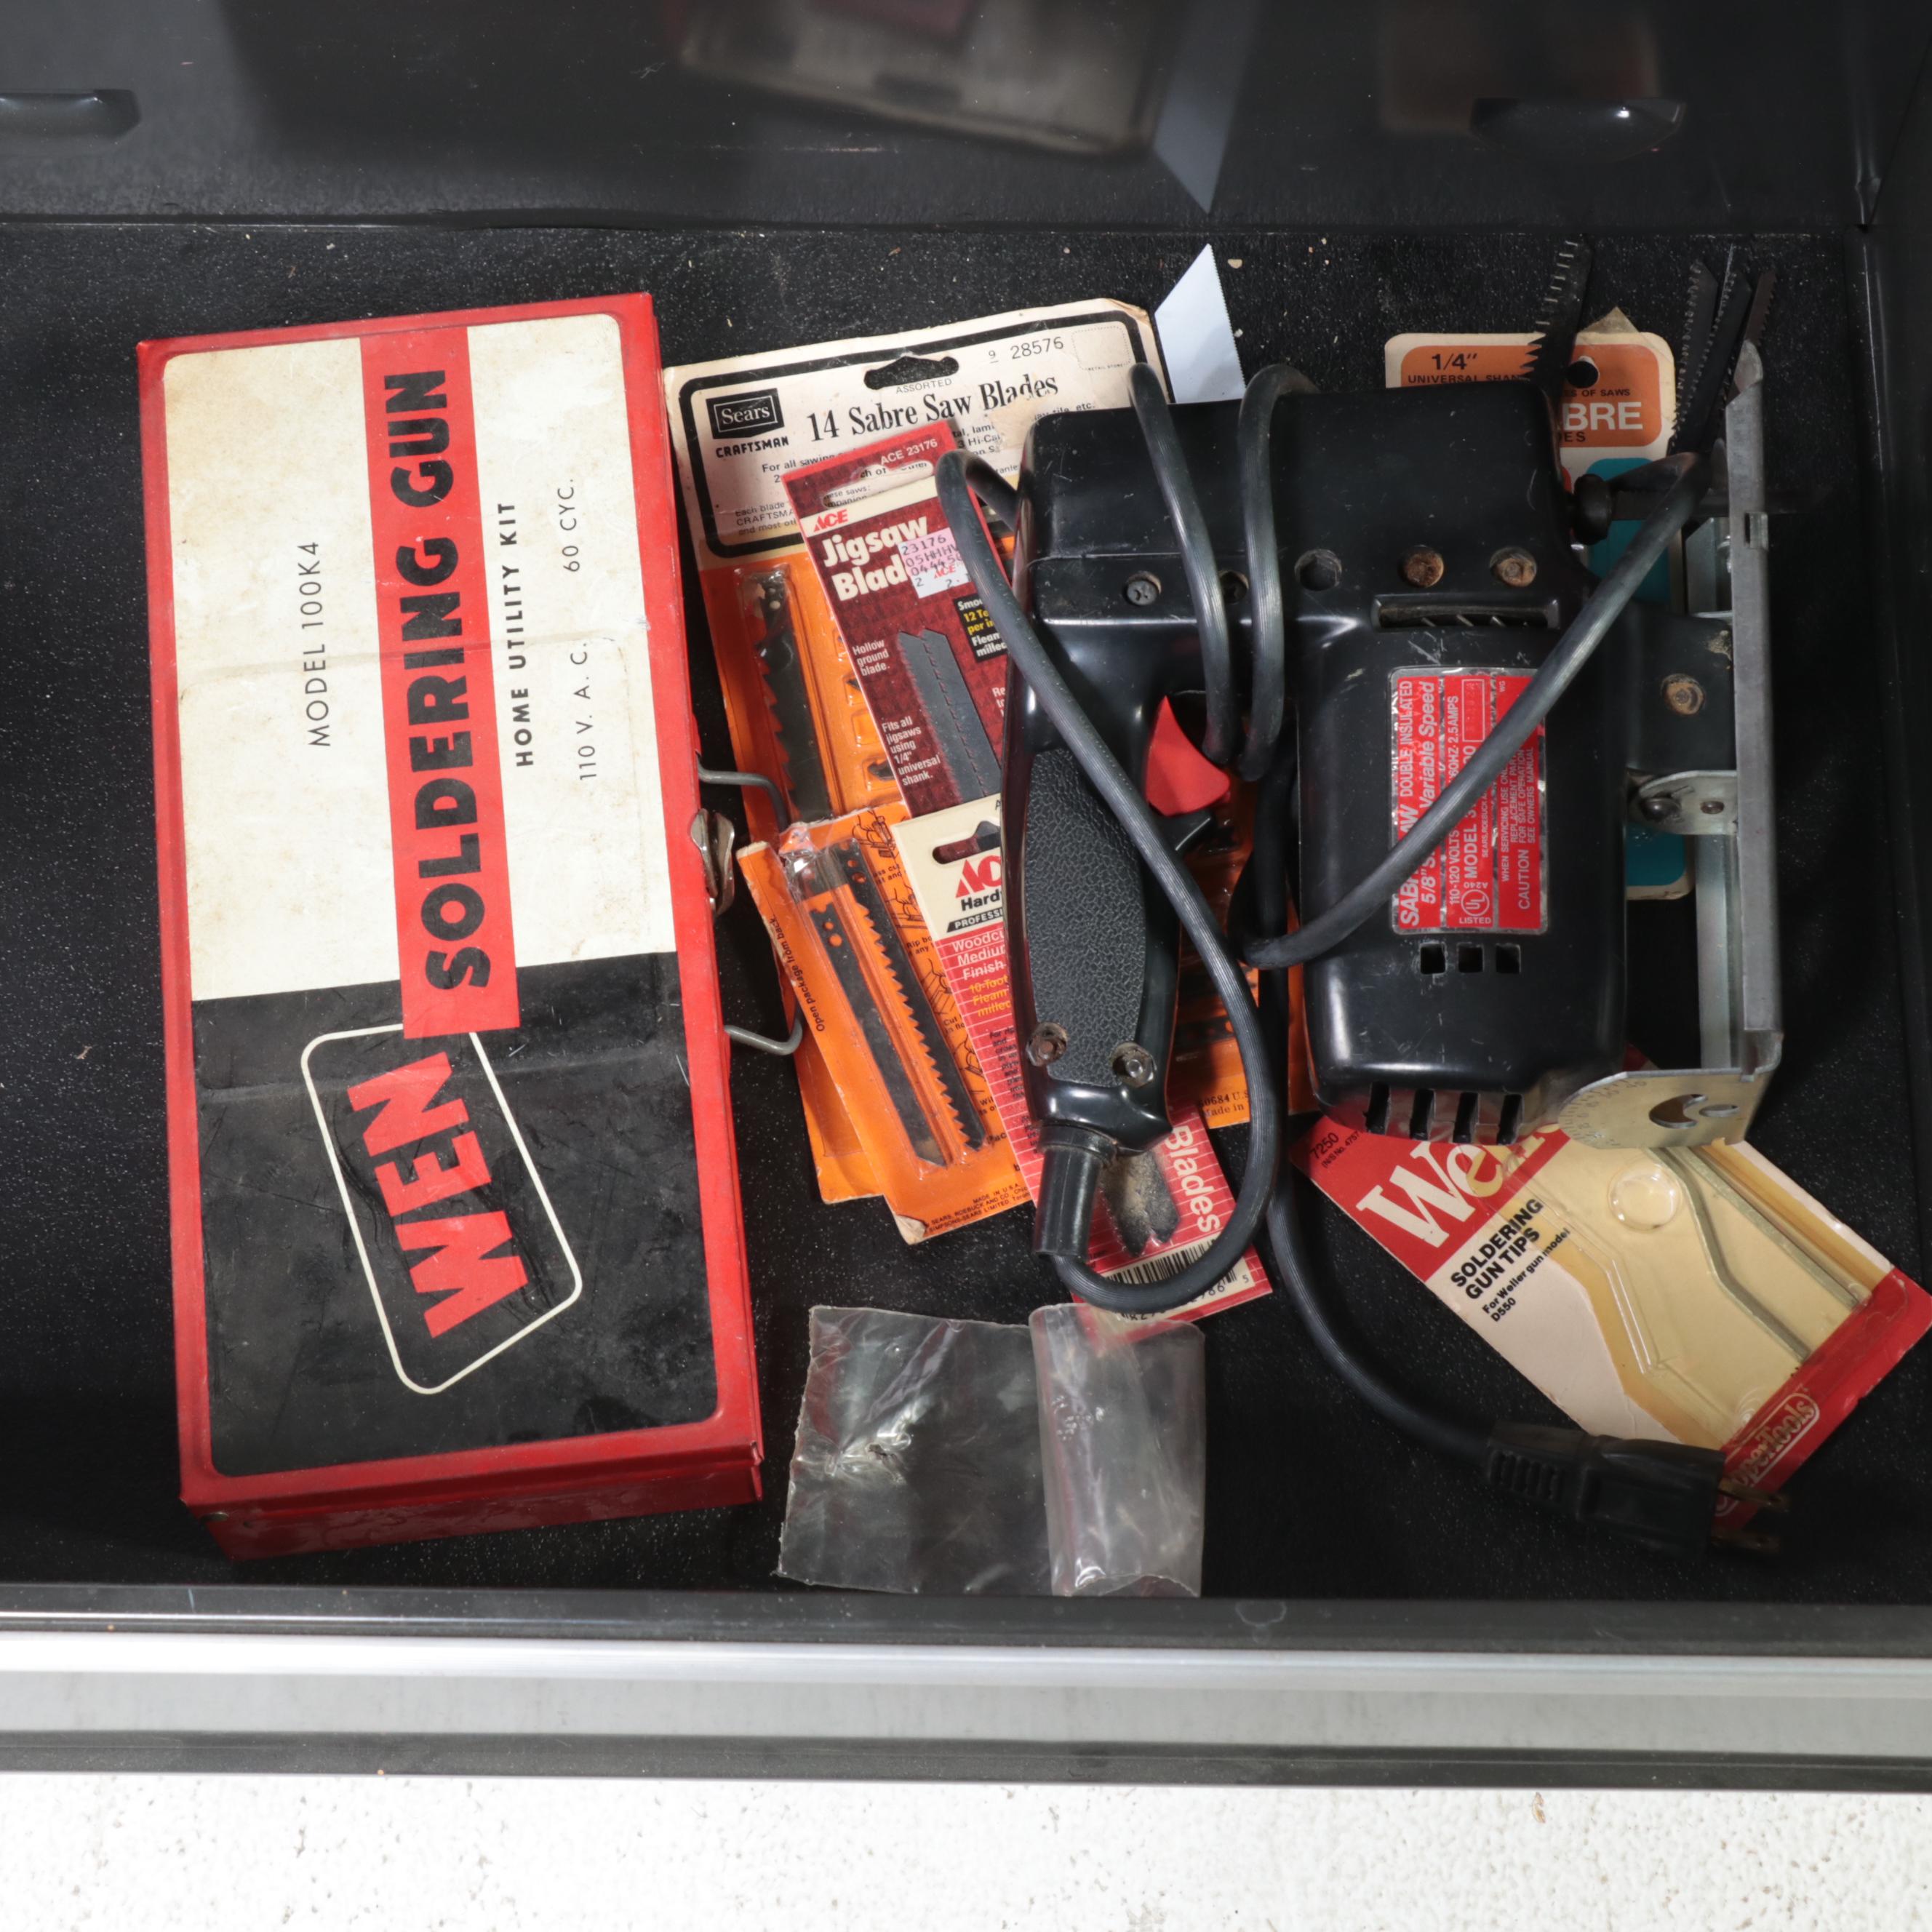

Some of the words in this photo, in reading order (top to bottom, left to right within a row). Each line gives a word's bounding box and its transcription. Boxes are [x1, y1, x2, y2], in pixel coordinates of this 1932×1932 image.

[1010, 337, 1064, 359] 28576
[896, 380, 951, 394] ASSORTED
[1408, 374, 1477, 383] UNIVERSAL
[1581, 389, 1596, 397] OF
[1600, 388, 1631, 397] SAWS
[721, 406, 770, 425] Sears
[807, 410, 839, 442] 14
[849, 403, 918, 436] Sabre
[923, 394, 971, 422] Saw
[978, 374, 1058, 411] Blades
[1077, 402, 1095, 411] etc.
[1562, 402, 1643, 431] BRE
[385, 370, 455, 508] GUN
[716, 436, 789, 458] CRAFTSMAN
[880, 447, 904, 466] ACE
[906, 439, 938, 456] 23176
[762, 463, 781, 473] For
[784, 460, 797, 469] all
[846, 485, 871, 495] saws:
[558, 478, 578, 532] CYC.
[498, 503, 517, 546] KIT
[736, 509, 794, 527] CRAFTSMA
[759, 522, 781, 532] most
[813, 509, 848, 532] ACE
[822, 516, 929, 568] Jigsaw
[901, 535, 946, 556] 23176
[564, 546, 581, 572] 60
[831, 554, 909, 602] Blad
[935, 565, 957, 579] ACE
[299, 541, 322, 629] 100K4
[957, 599, 983, 611] Smo
[963, 611, 977, 622] 12
[502, 565, 526, 671] UTILITY
[967, 623, 984, 636] per
[852, 639, 885, 655] Hollow
[856, 650, 889, 667] ground
[860, 661, 890, 676] blade.
[300, 644, 330, 747] MODEL
[1400, 681, 1413, 746] INSULATED
[1419, 681, 1437, 738] Speed
[512, 688, 535, 767] HOME
[576, 714, 594, 735] V.
[882, 719, 900, 733] Fits
[900, 716, 913, 728] all
[886, 726, 922, 745] jigsaws
[890, 740, 917, 754] using
[396, 532, 492, 989] SOLDERING
[577, 744, 596, 781] 110
[898, 754, 941, 775] universal
[1400, 749, 1413, 797] DOUBLE
[1526, 748, 1535, 783] MANUAL
[902, 770, 933, 786] shank.
[1419, 741, 1436, 808] Variable
[1517, 749, 1526, 799] OPERATION
[1501, 786, 1509, 803] USE
[1527, 786, 1536, 823] OWNERS
[1510, 780, 1519, 843] REPLACEMENT
[1518, 801, 1526, 824] SAFE
[1501, 807, 1509, 853] SERVICING
[1518, 826, 1526, 844] FOR
[1527, 827, 1536, 844] SEE
[1448, 830, 1461, 864] VOLTS
[1464, 824, 1478, 879] MODEL
[955, 855, 1002, 899] AC
[1501, 856, 1509, 882] WHEN
[1518, 849, 1530, 909] CAUTION
[1449, 866, 1461, 905] 110-120
[960, 887, 1002, 912] Hard
[954, 909, 1003, 930] PROFESSI
[781, 940, 796, 962] from
[962, 960, 1006, 981] Finish
[791, 965, 815, 1005] package
[969, 974, 1009, 994] 10-Toot
[809, 1007, 825, 1031] Open
[1205, 1106, 1231, 1117] ade
[1234, 1103, 1245, 1112] in
[1310, 1133, 1339, 1159] 7250
[1165, 1125, 1221, 1233] Blades
[348, 1051, 528, 1338] WEN
[973, 1193, 990, 1203] MADE
[1450, 1198, 1544, 1288] SOLDERING
[1465, 1261, 1506, 1300] GUN
[1498, 1227, 1541, 1266] TIPS
[1482, 1299, 1498, 1314] For
[1496, 1271, 1528, 1300] Weller
[1525, 1254, 1545, 1275] gun
[1544, 1228, 1570, 1257] model
[1242, 1274, 1250, 1283] 5
[1490, 1297, 1517, 1322] D550
[1718, 1400, 1815, 1509] operTools
